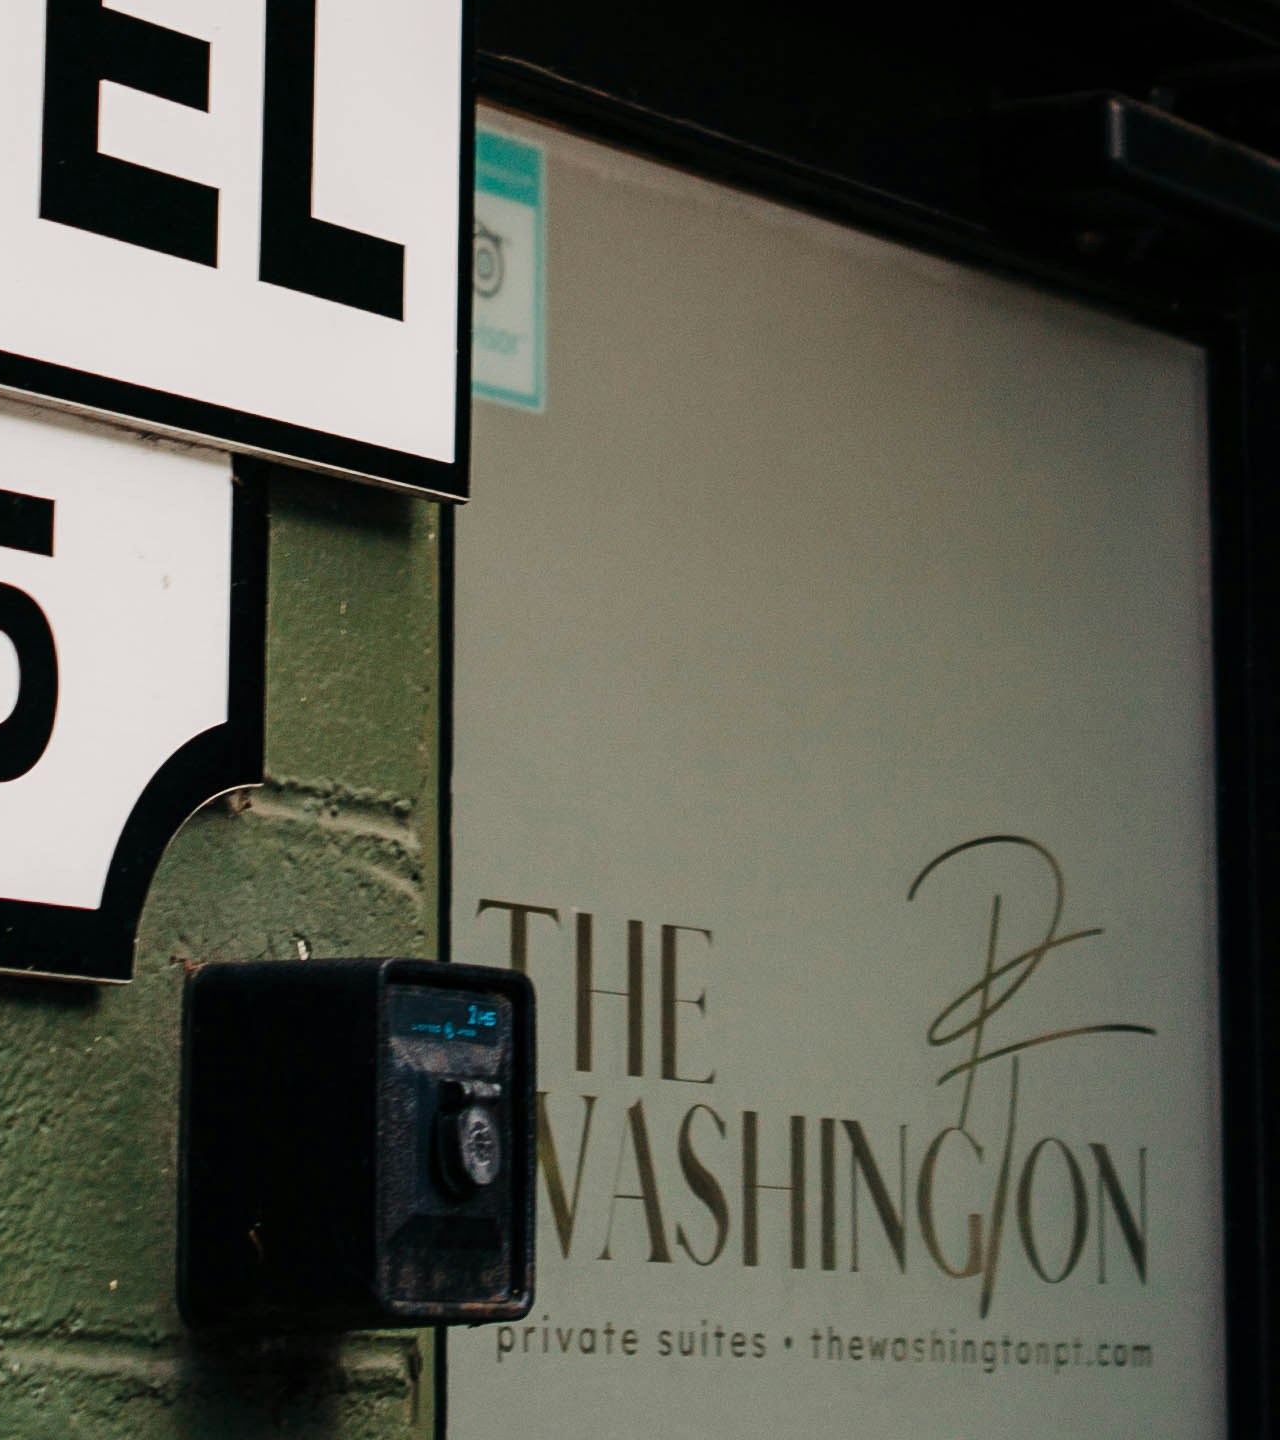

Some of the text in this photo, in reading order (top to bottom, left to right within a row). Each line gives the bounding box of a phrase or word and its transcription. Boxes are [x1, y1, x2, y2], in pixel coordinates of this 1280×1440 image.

[476, 898, 716, 1084] THE
[496, 1315, 1154, 1372] private suites thewashingtonpt.com
